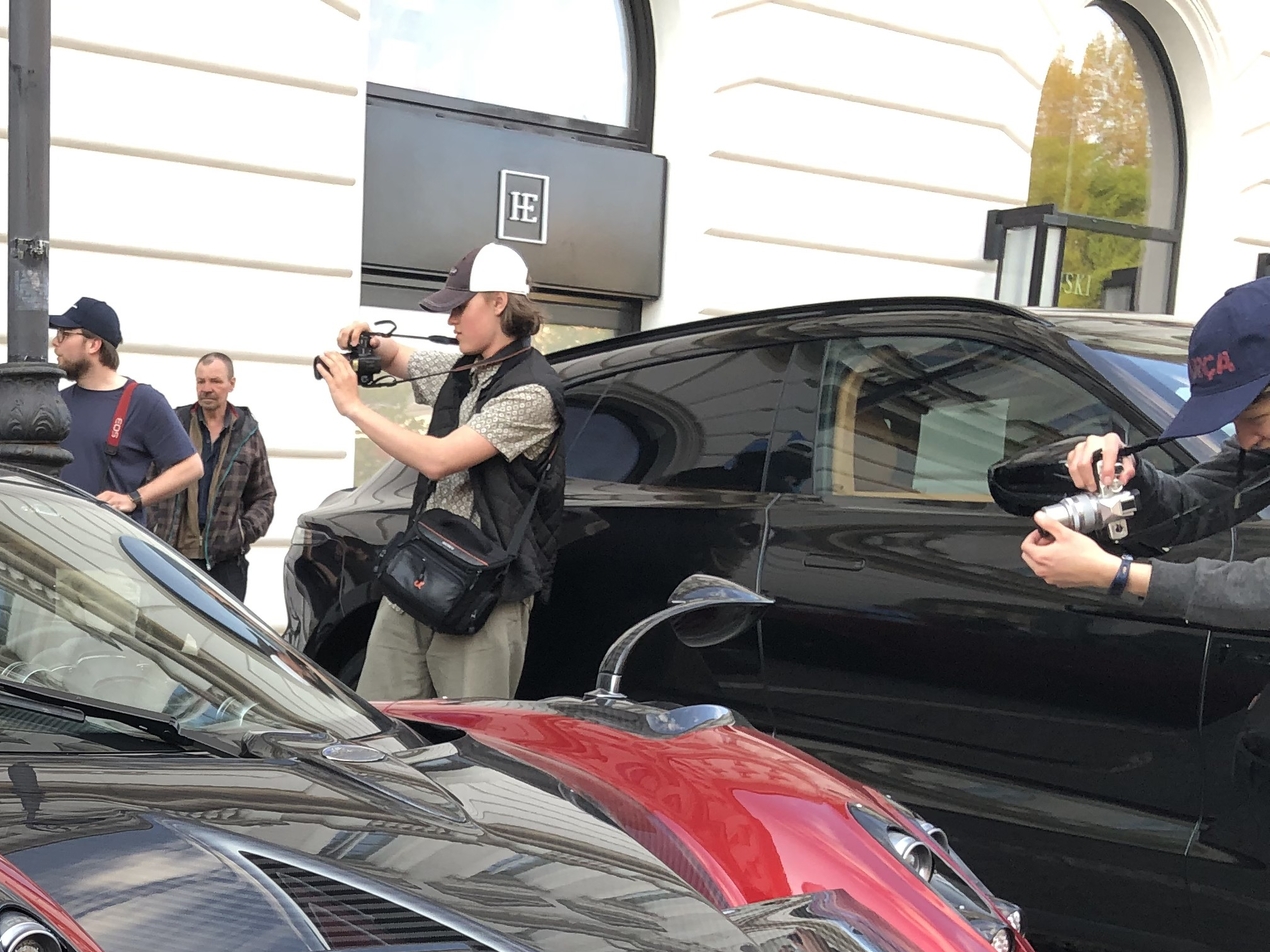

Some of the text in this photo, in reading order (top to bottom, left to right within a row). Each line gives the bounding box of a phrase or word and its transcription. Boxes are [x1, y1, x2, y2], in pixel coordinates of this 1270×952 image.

[509, 191, 538, 223] HE
[1061, 272, 1091, 296] SKI
[111, 417, 123, 438] EOS
